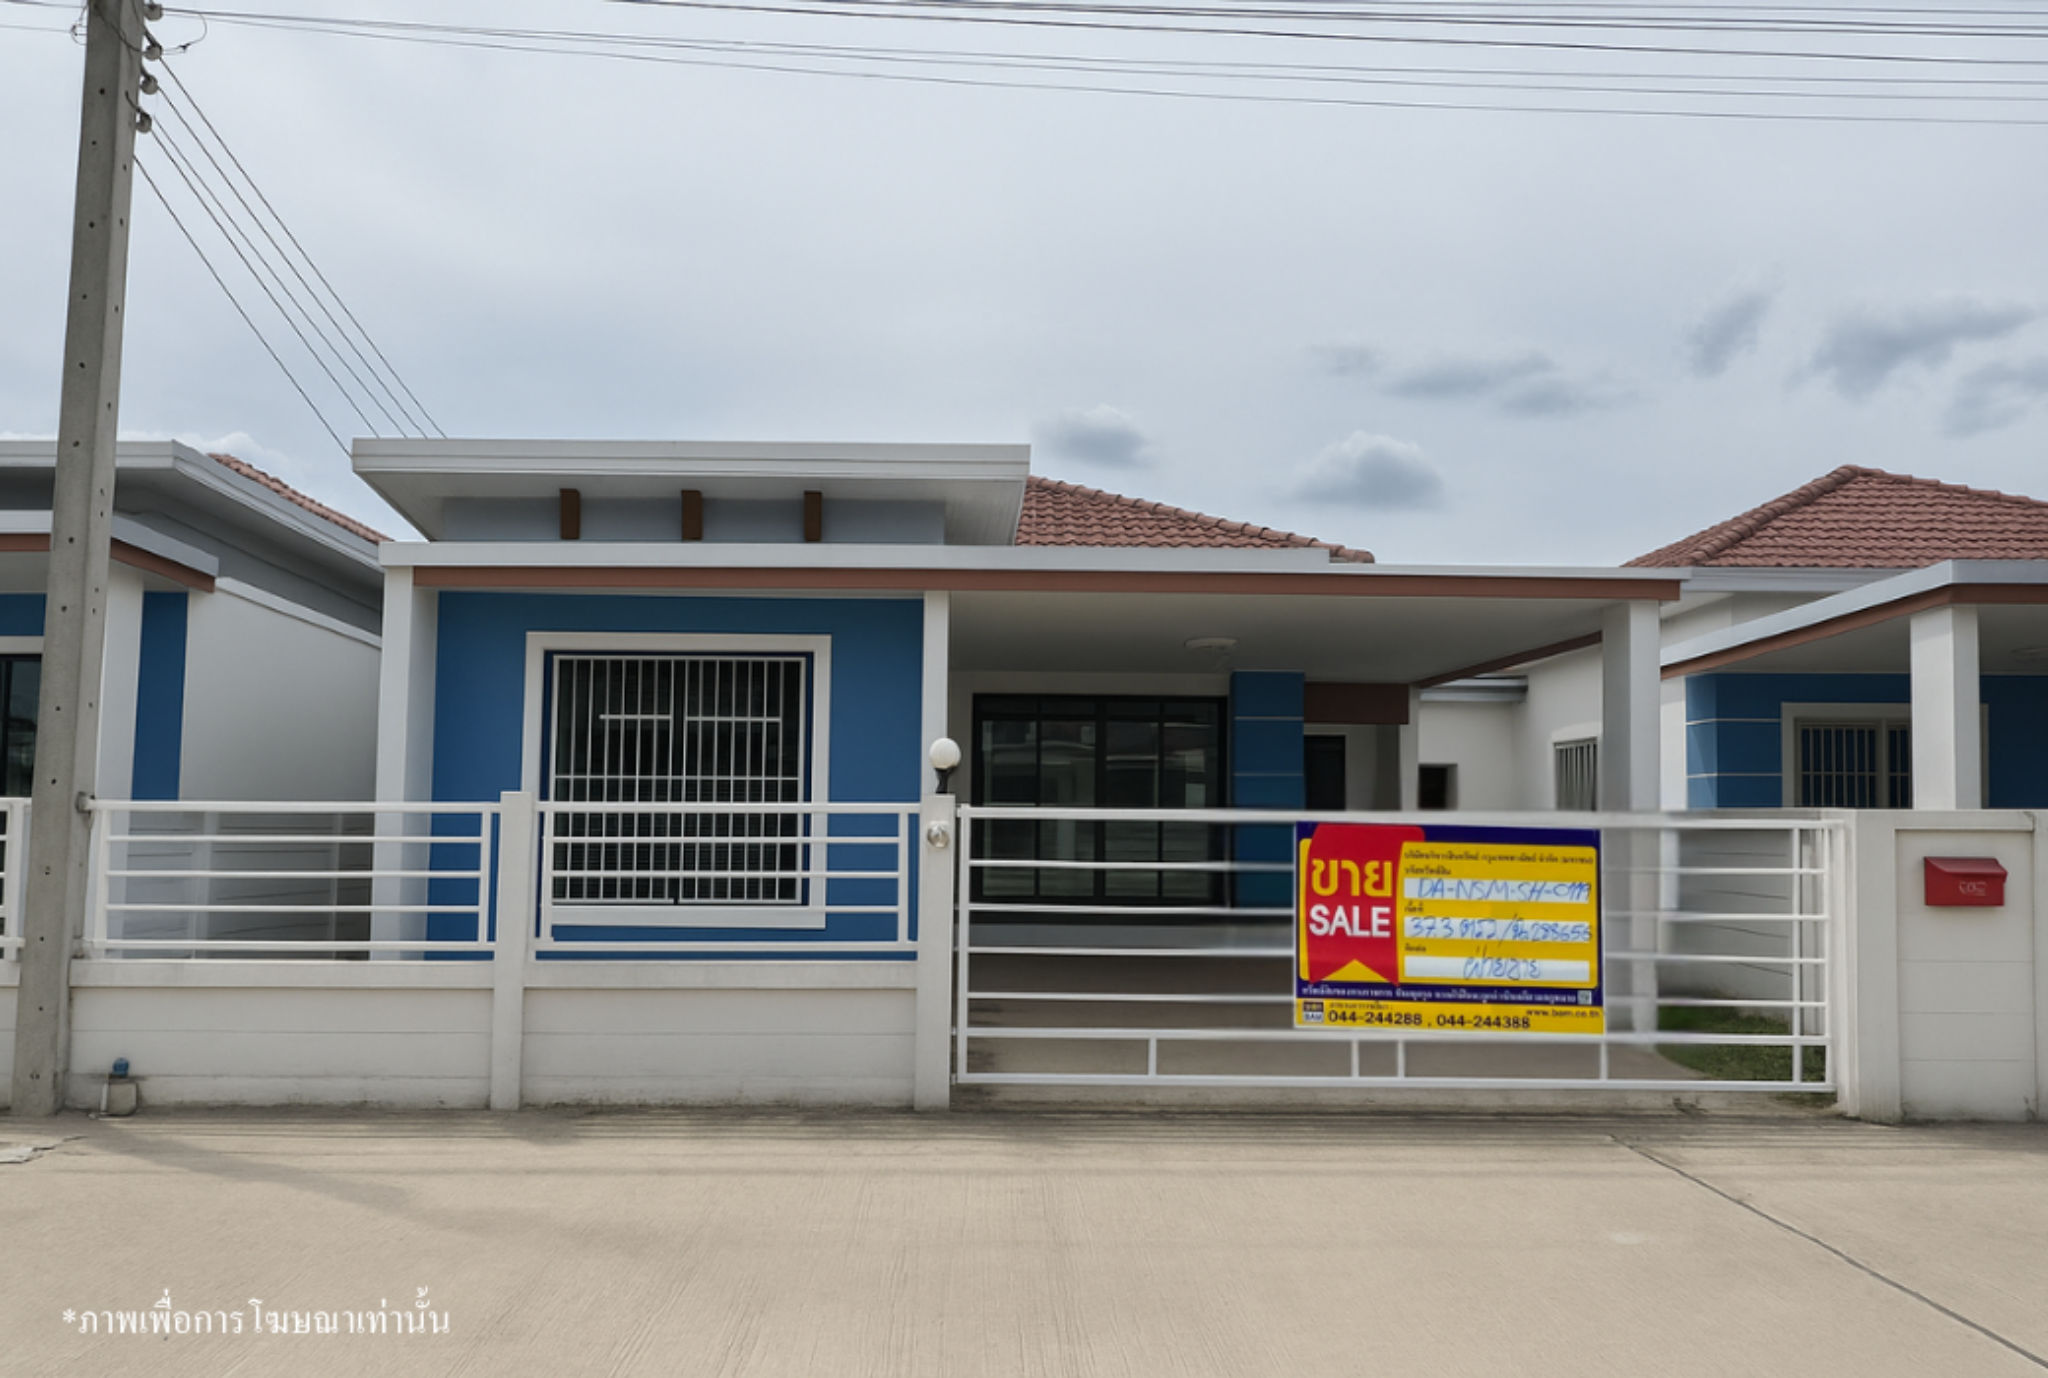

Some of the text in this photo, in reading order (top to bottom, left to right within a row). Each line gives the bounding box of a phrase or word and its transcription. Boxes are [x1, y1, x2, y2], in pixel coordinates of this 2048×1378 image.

[1311, 859, 1392, 897] ขาย
[1309, 904, 1391, 938] SALE
[1328, 1010, 1422, 1025] 044-244288
[1437, 1014, 1531, 1028] 044-244388
